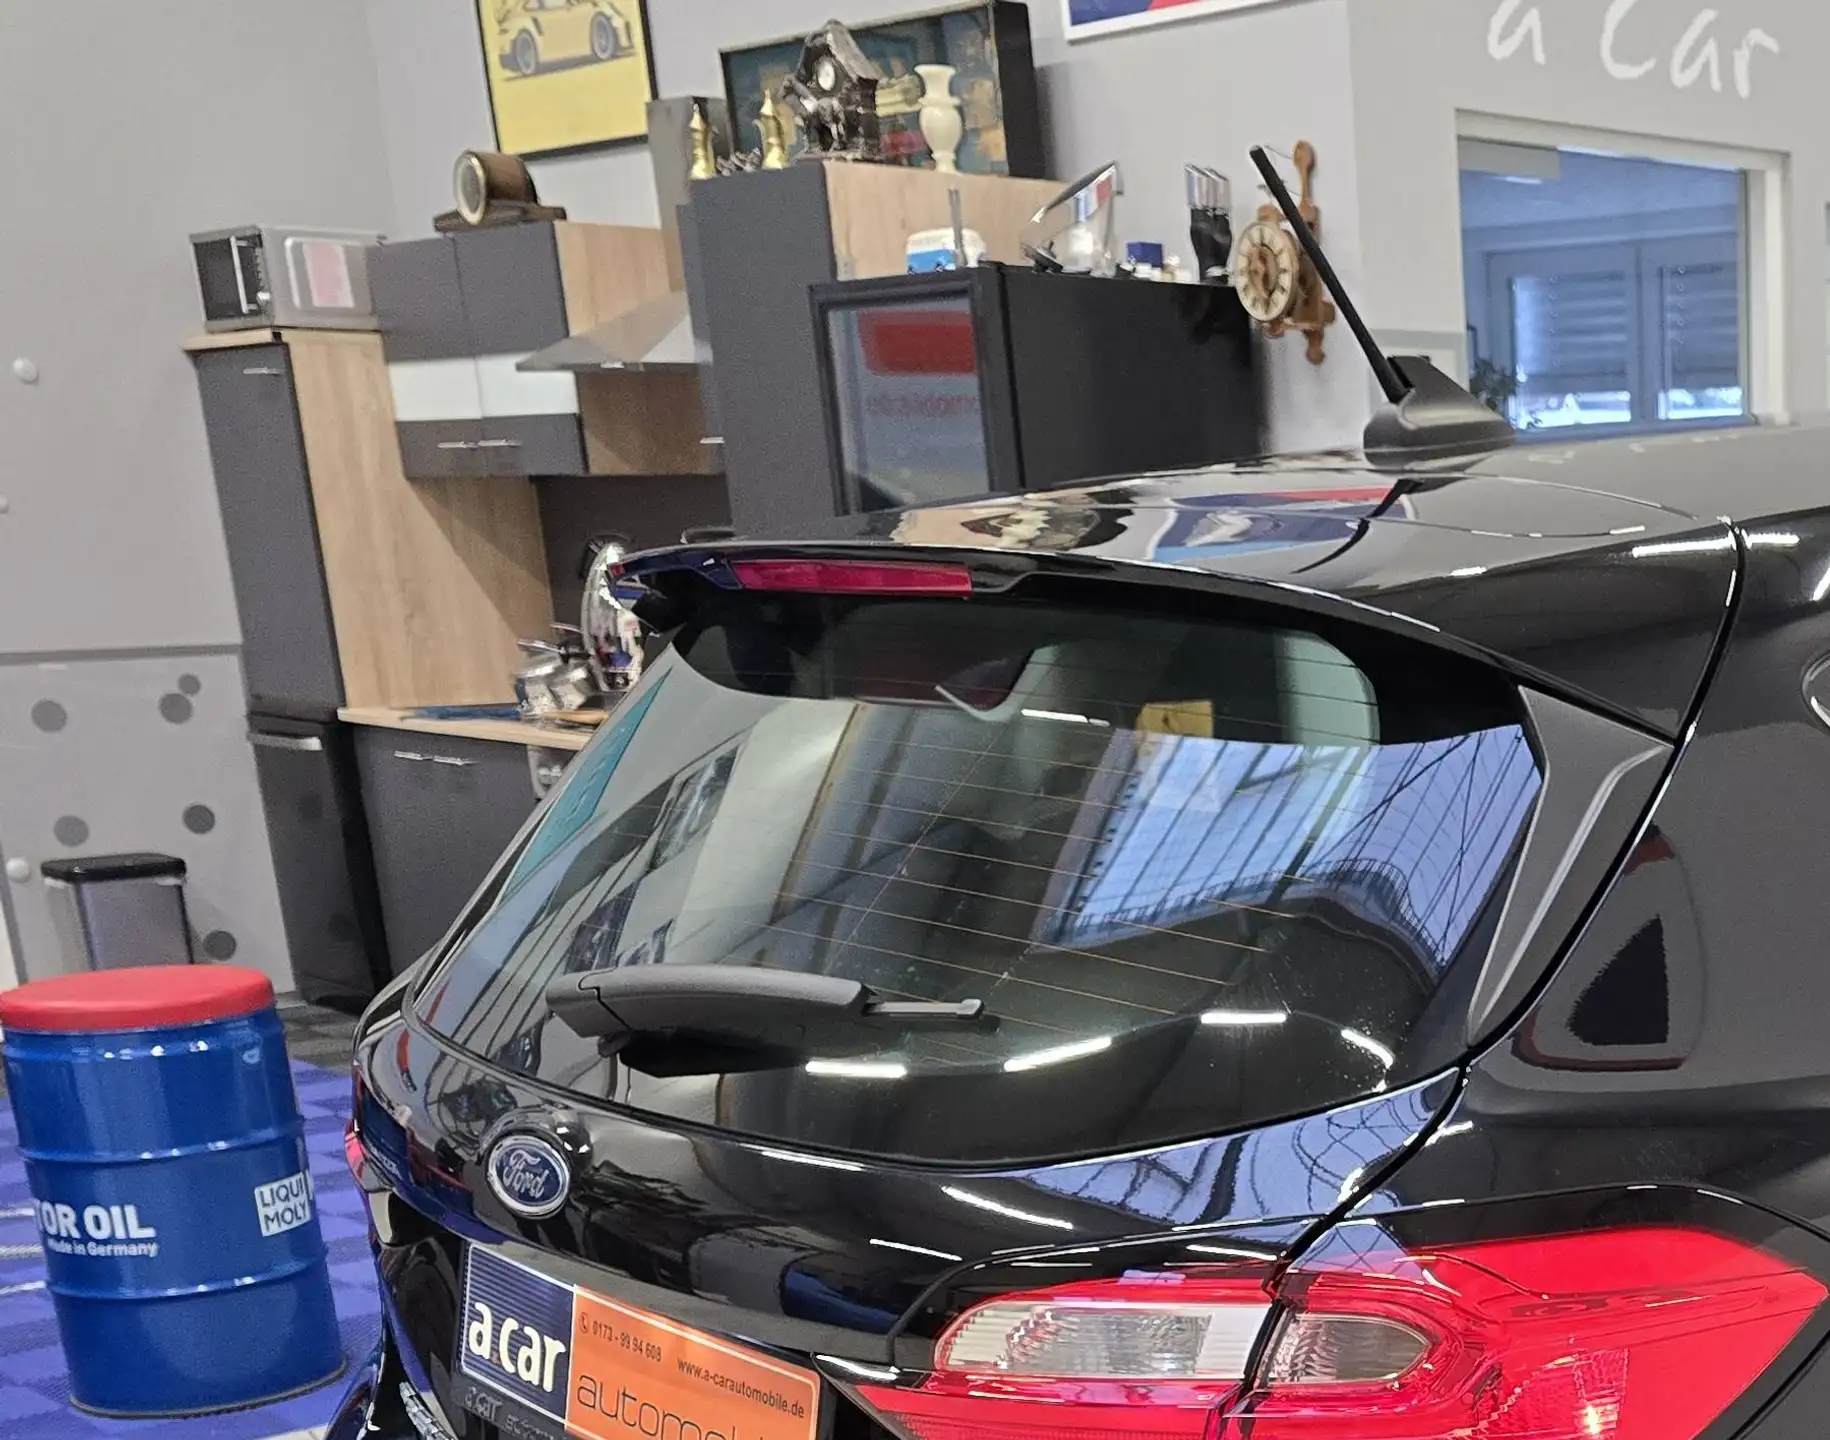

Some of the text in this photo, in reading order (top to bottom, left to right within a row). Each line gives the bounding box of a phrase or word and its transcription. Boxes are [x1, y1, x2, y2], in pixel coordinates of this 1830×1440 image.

[502, 1149, 549, 1199] Ford
[259, 1175, 304, 1208] LIQUI
[83, 1205, 156, 1239] OIL
[263, 1200, 306, 1232] MOLY
[73, 1242, 87, 1255] in
[86, 1241, 159, 1258] Germany
[676, 1357, 805, 1419] www.a-carautomobile.de
